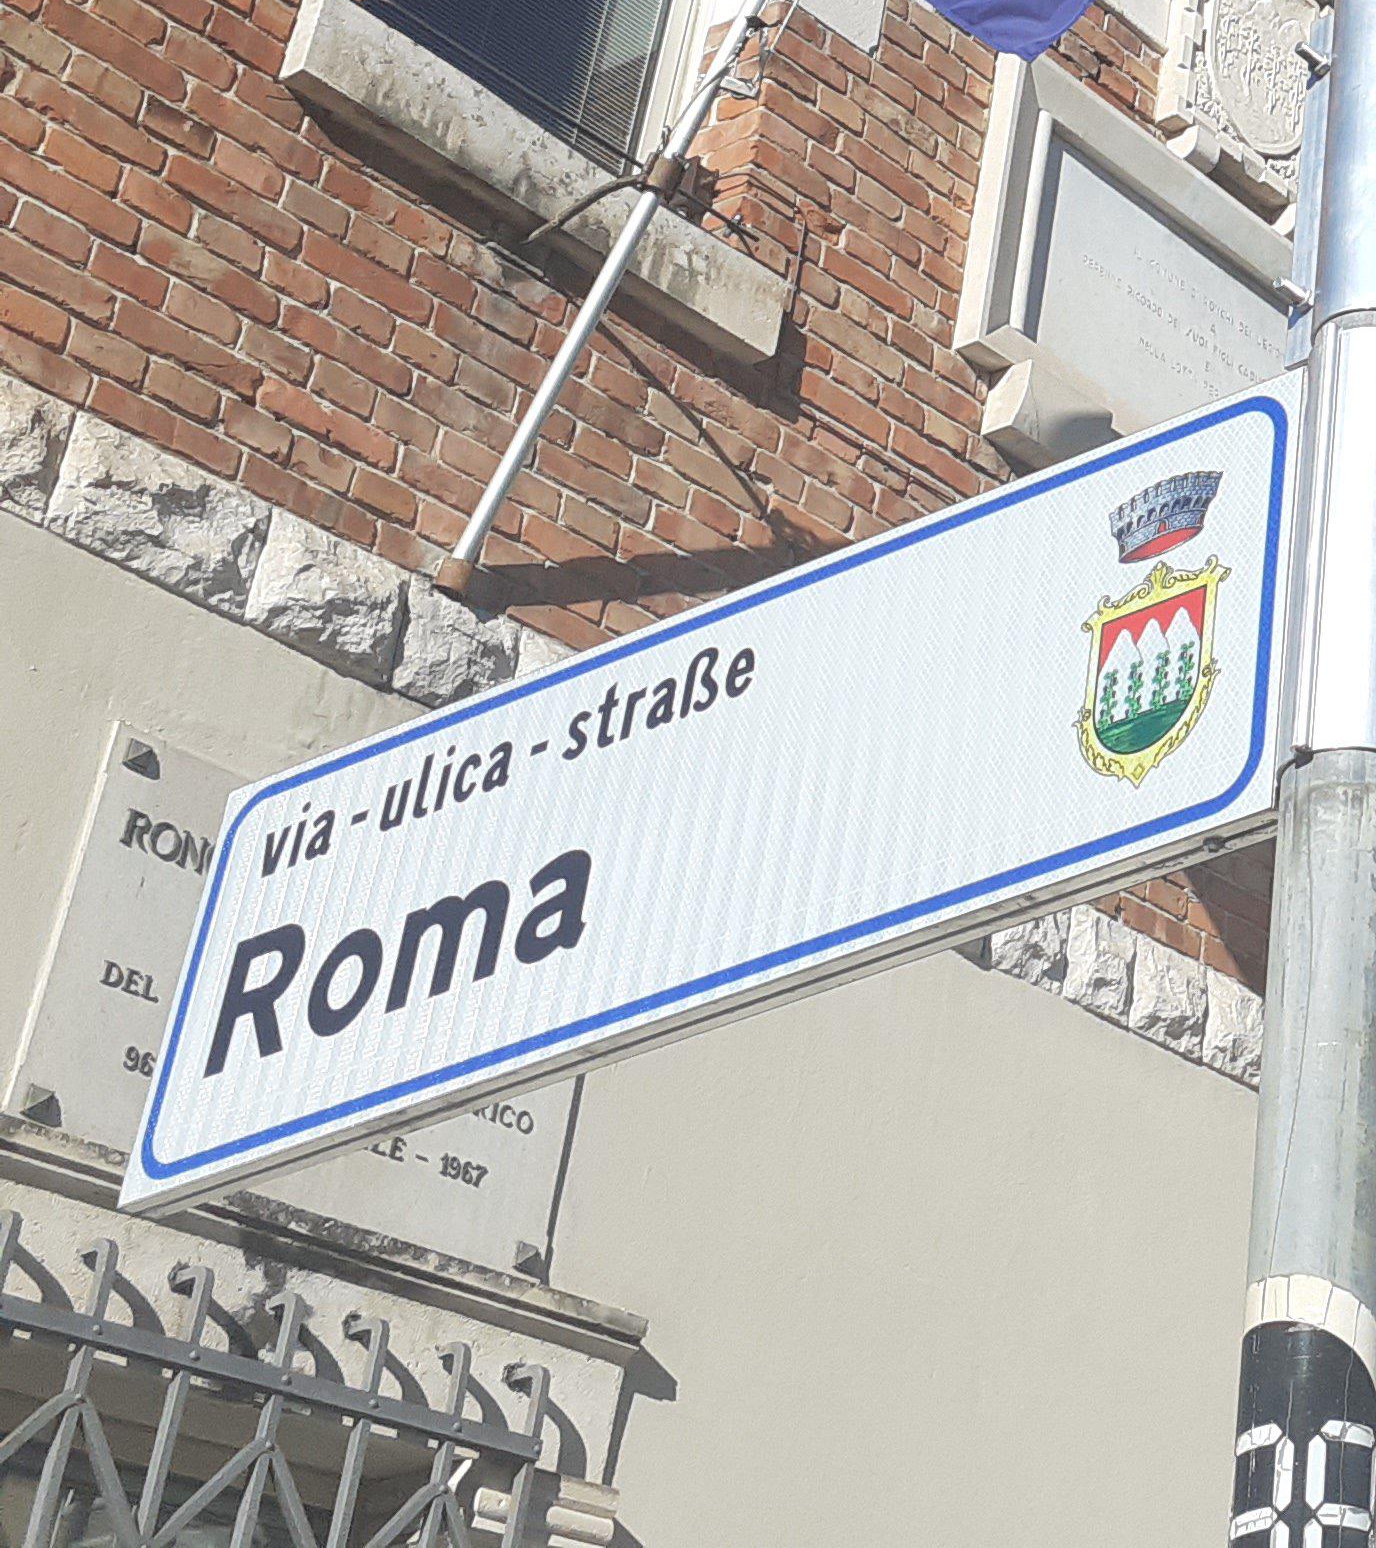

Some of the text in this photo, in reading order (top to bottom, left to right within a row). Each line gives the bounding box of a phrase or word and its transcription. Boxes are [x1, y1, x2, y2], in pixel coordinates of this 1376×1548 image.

[119, 807, 217, 877] RON
[99, 960, 159, 1004] DEL
[203, 849, 592, 1078] Roma
[438, 1152, 490, 1189] 1967
